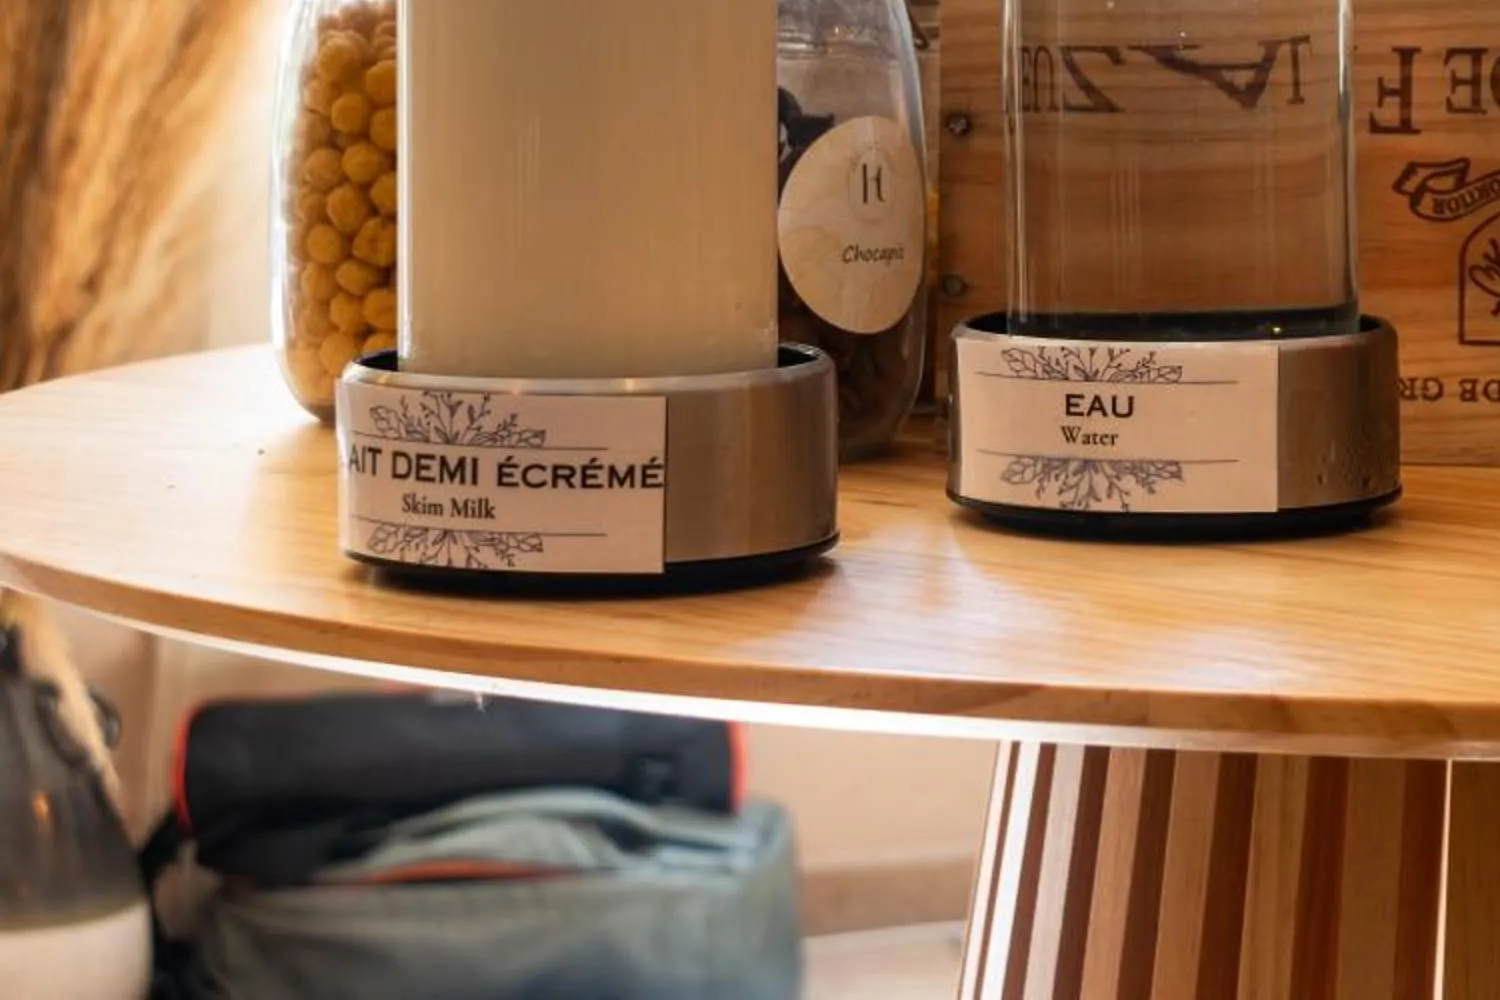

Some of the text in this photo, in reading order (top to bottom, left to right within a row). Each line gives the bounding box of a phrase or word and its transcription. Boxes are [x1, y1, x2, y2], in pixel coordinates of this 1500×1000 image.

[1065, 393, 1135, 419] EAU
[1060, 425, 1119, 448] Water
[391, 450, 480, 486] DEMI
[496, 455, 665, 490] ÉCRÉMÉ
[401, 493, 496, 521] Skim Milk
